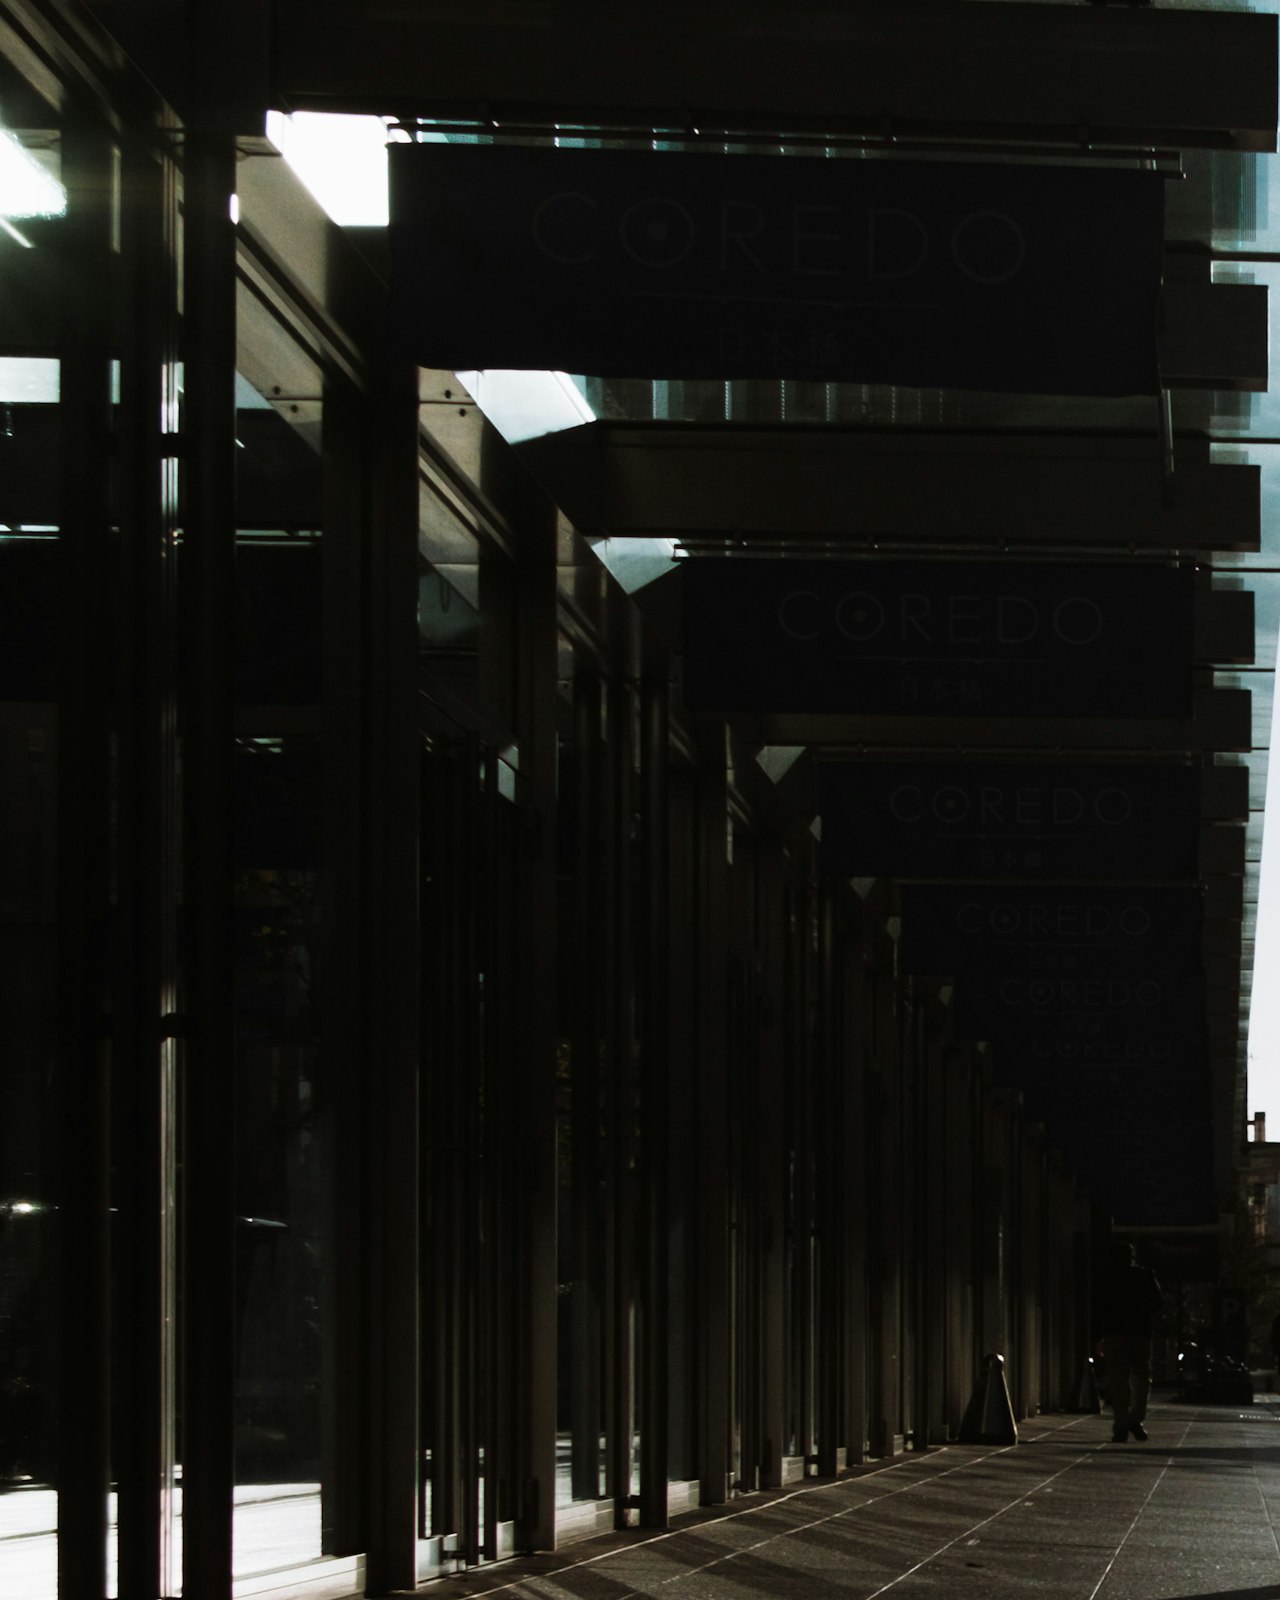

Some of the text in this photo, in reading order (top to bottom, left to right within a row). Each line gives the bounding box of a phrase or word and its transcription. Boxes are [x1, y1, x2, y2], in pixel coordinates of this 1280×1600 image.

[531, 191, 1027, 285] COREDO
[716, 326, 845, 367] 日本橋
[777, 590, 1104, 645] COREDO
[888, 784, 1133, 826] COREDO
[955, 903, 1151, 936] COREDO
[999, 978, 1162, 1006] COREDO
[1222, 1298, 1240, 1323] P
